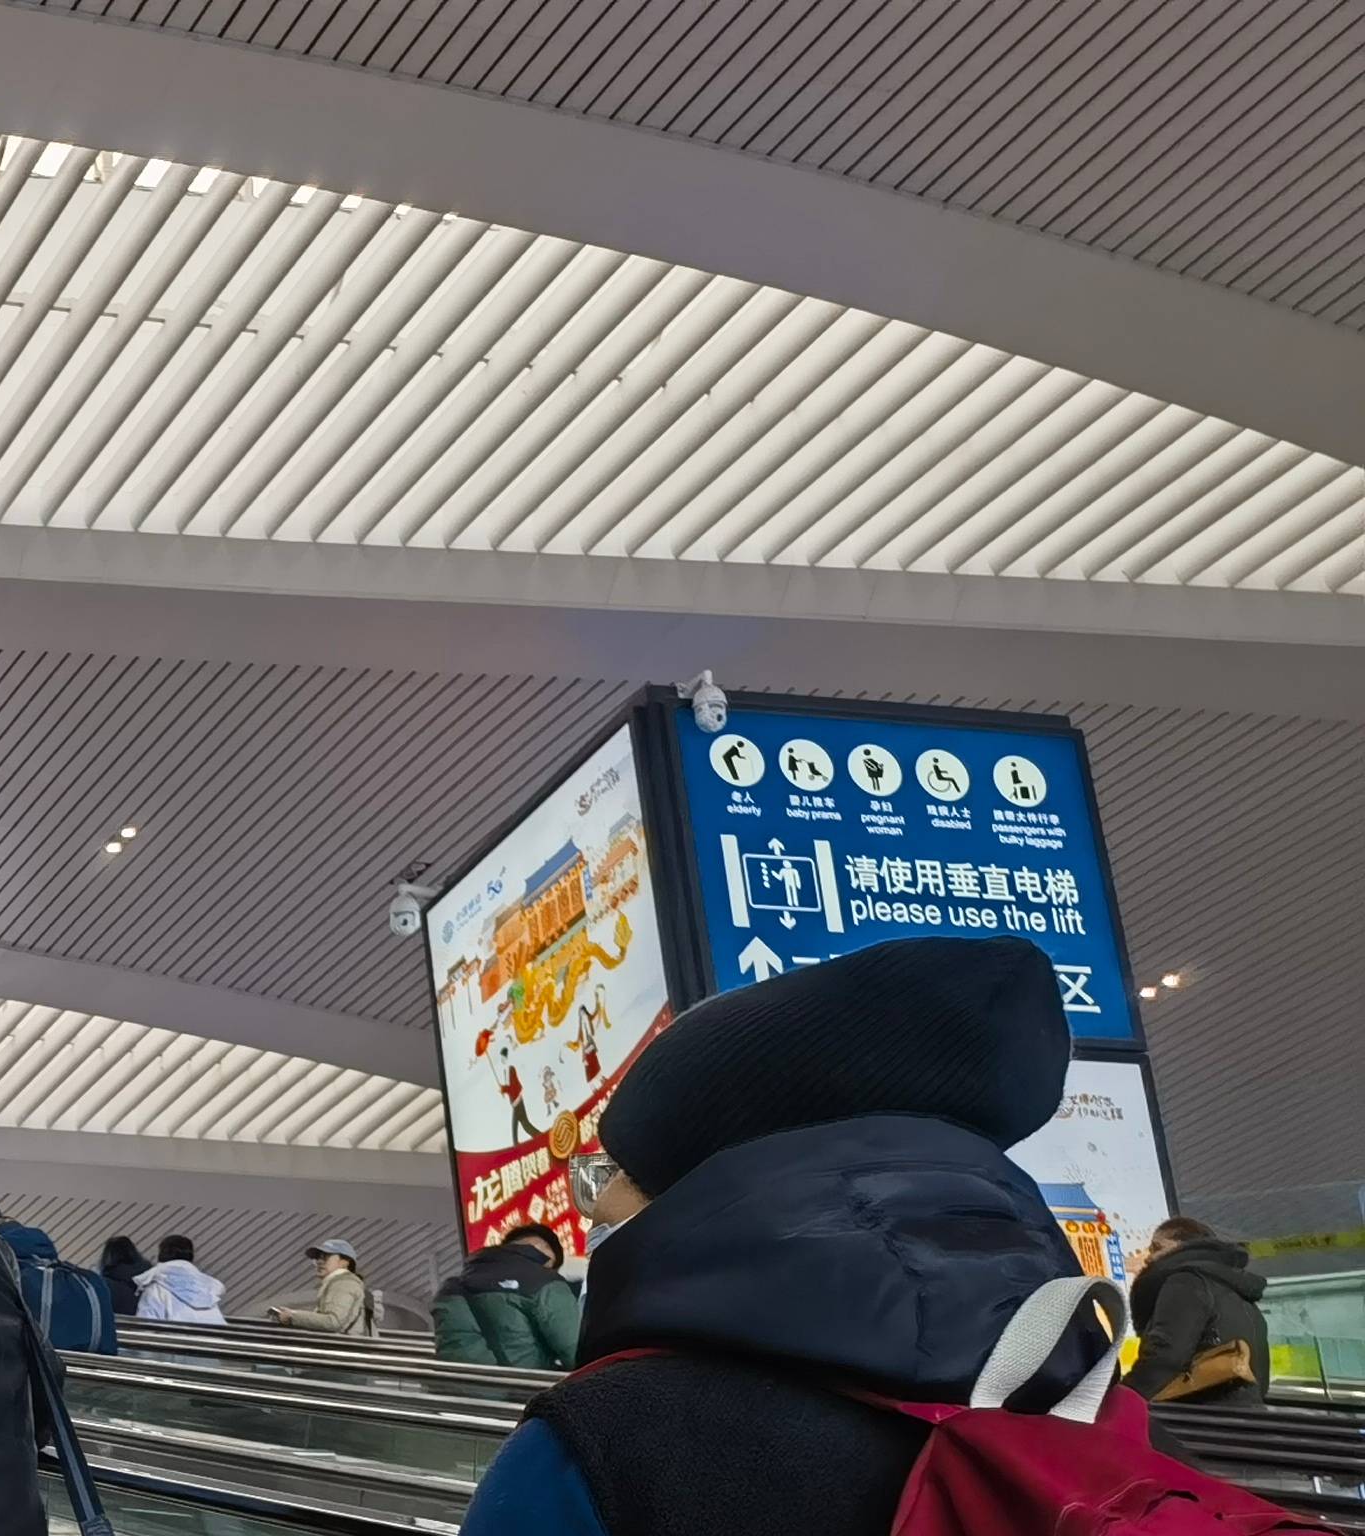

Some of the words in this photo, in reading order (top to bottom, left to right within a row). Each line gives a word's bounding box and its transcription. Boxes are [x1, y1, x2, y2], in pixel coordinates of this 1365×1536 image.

[726, 803, 762, 817] elderly
[785, 807, 810, 820] baby
[811, 809, 842, 822] prams
[860, 812, 905, 828] pregnant
[931, 817, 971, 831] disabled
[866, 825, 903, 837] woman
[991, 822, 1042, 837] passengers
[1043, 825, 1066, 838] with
[844, 854, 1080, 907] 请使用垂直电梯
[850, 894, 942, 926] please
[949, 904, 998, 929] use
[1003, 904, 1047, 933] the
[1051, 906, 1087, 936] lift
